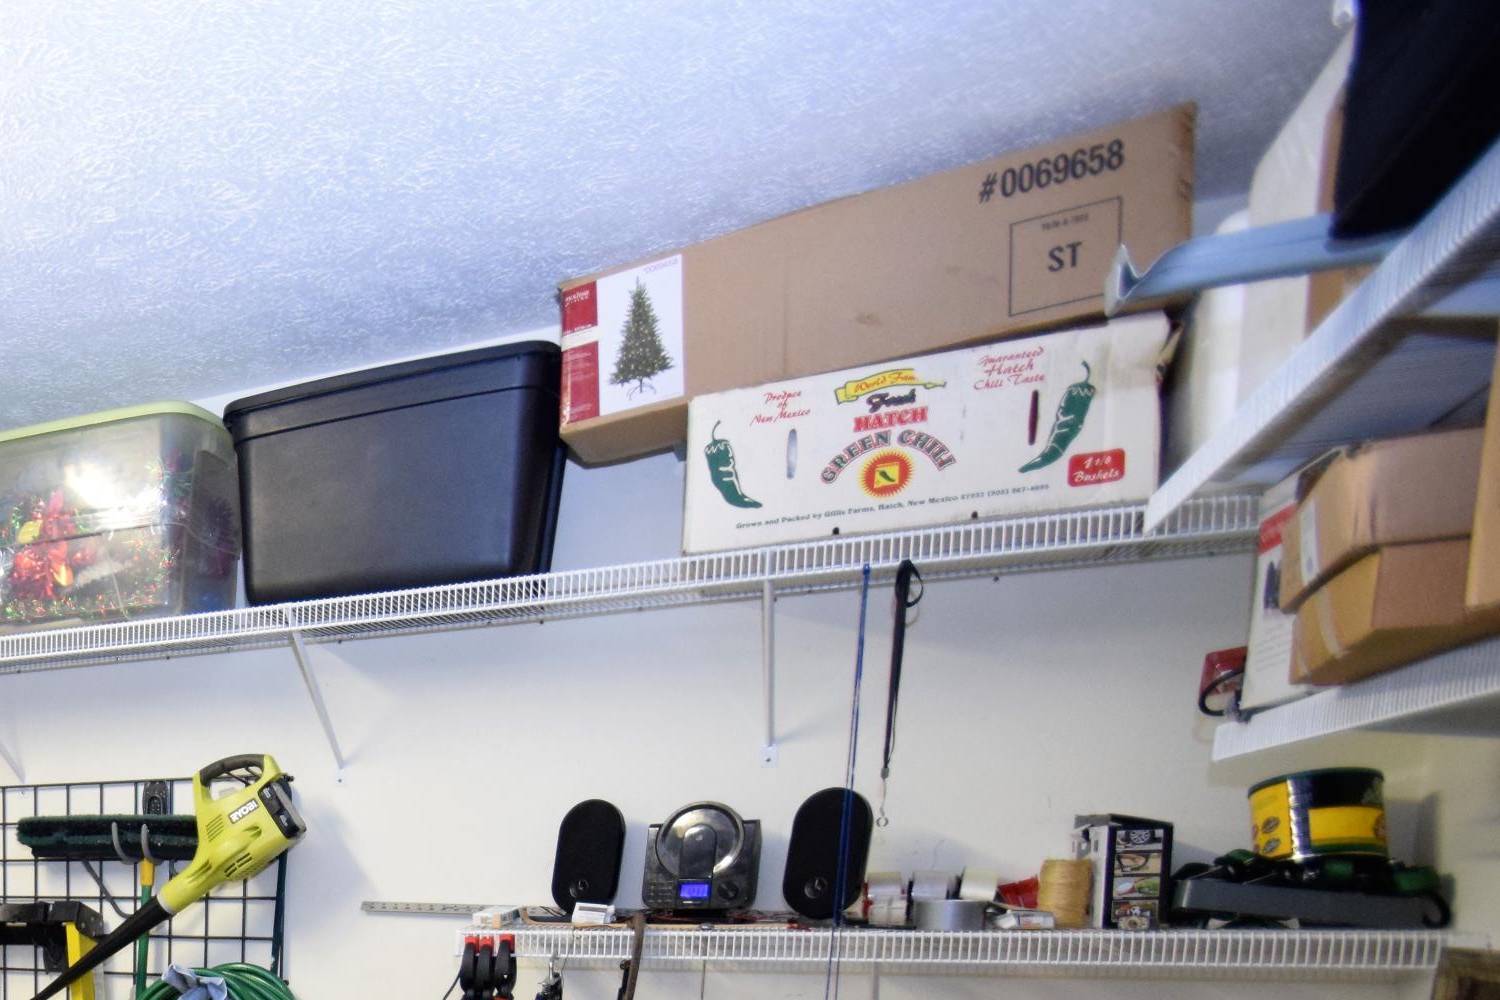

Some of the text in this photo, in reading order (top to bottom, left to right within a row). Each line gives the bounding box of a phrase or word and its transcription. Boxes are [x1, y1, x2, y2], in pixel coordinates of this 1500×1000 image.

[979, 138, 1124, 204] #0069658
[1047, 241, 1083, 272] ST
[978, 345, 1045, 366] Guaranteed
[984, 359, 1034, 377] Hatch
[854, 375, 886, 393] World
[1007, 374, 1045, 386] Taste
[763, 390, 802, 404] Produce
[749, 408, 811, 426] New Mexico
[853, 406, 929, 432] HATCH
[820, 429, 891, 484] GREEN
[736, 521, 763, 530] Grown
[764, 518, 779, 526] and
[781, 514, 810, 524] Packed
[908, 498, 925, 507] New
[929, 495, 958, 504] Mexico
[230, 799, 258, 822] RYOBI
